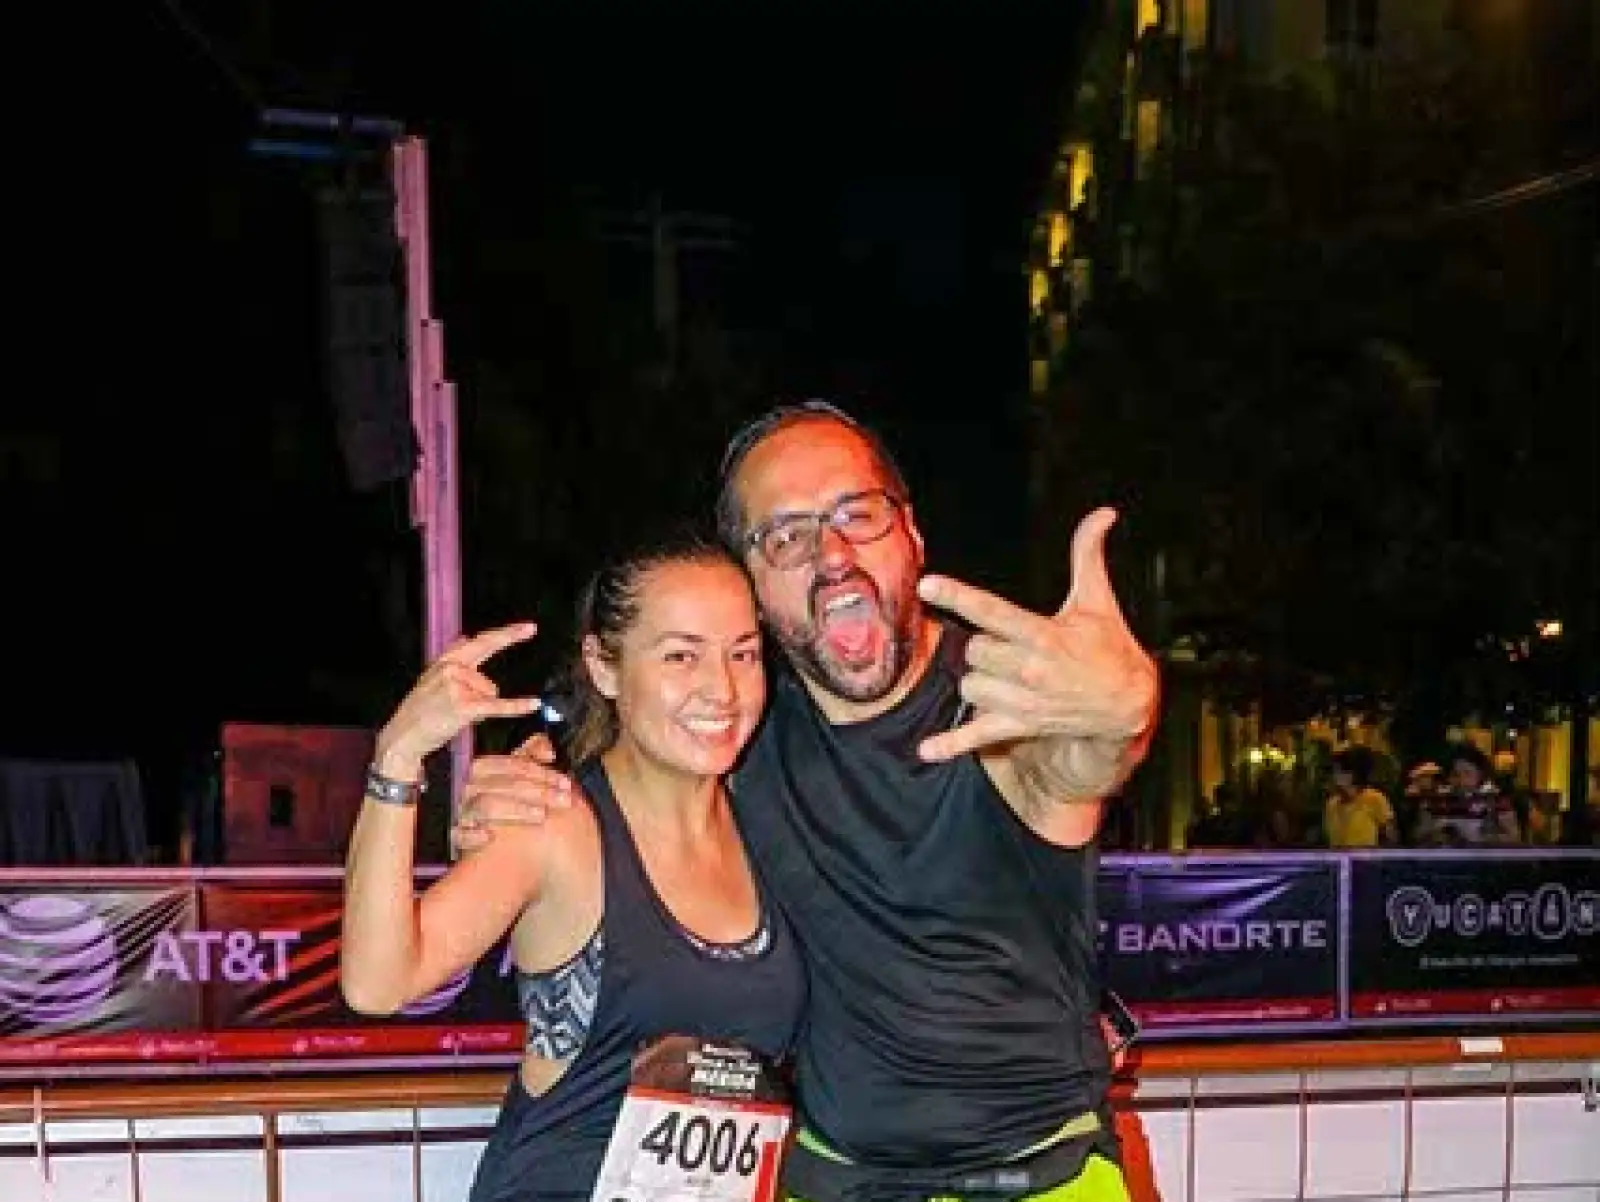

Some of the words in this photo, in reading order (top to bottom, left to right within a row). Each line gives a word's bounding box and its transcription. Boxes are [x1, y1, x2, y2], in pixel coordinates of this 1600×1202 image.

[142, 930, 300, 982] AT&T
[1118, 920, 1327, 951] BANORTE
[638, 1111, 761, 1177] 4006
